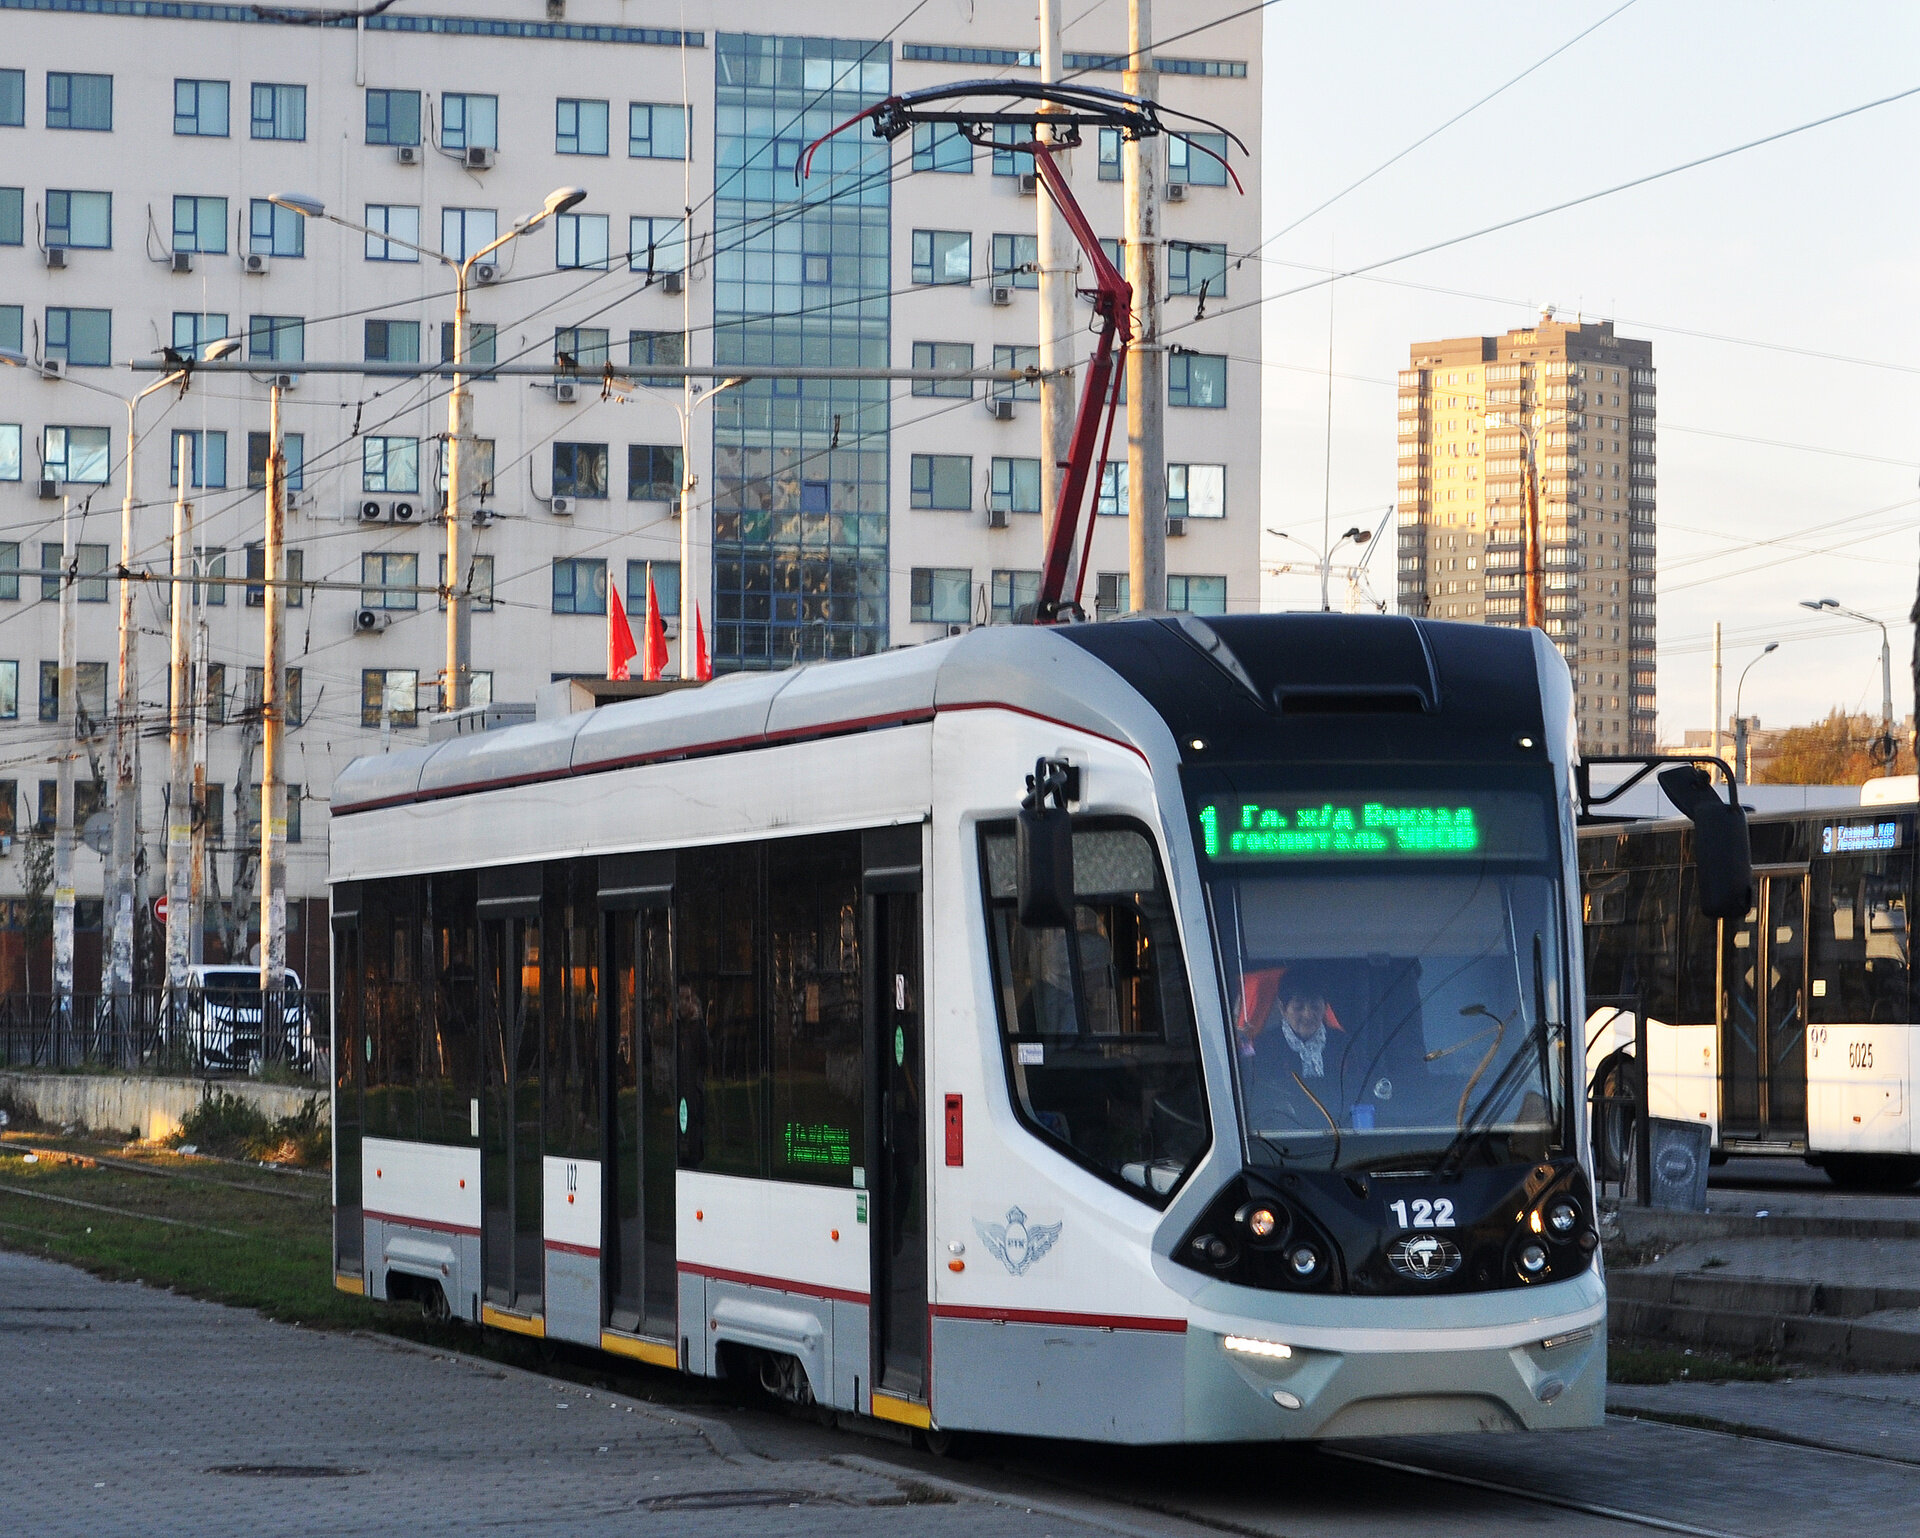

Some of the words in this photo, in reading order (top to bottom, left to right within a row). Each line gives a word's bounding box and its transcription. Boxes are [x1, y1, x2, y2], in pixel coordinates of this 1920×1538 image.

[1199, 805, 1216, 855] 1
[1822, 827, 1832, 853] 3
[1849, 1042, 1873, 1068] 6025
[567, 1163, 577, 1192] 122
[1389, 1198, 1456, 1229] 122
